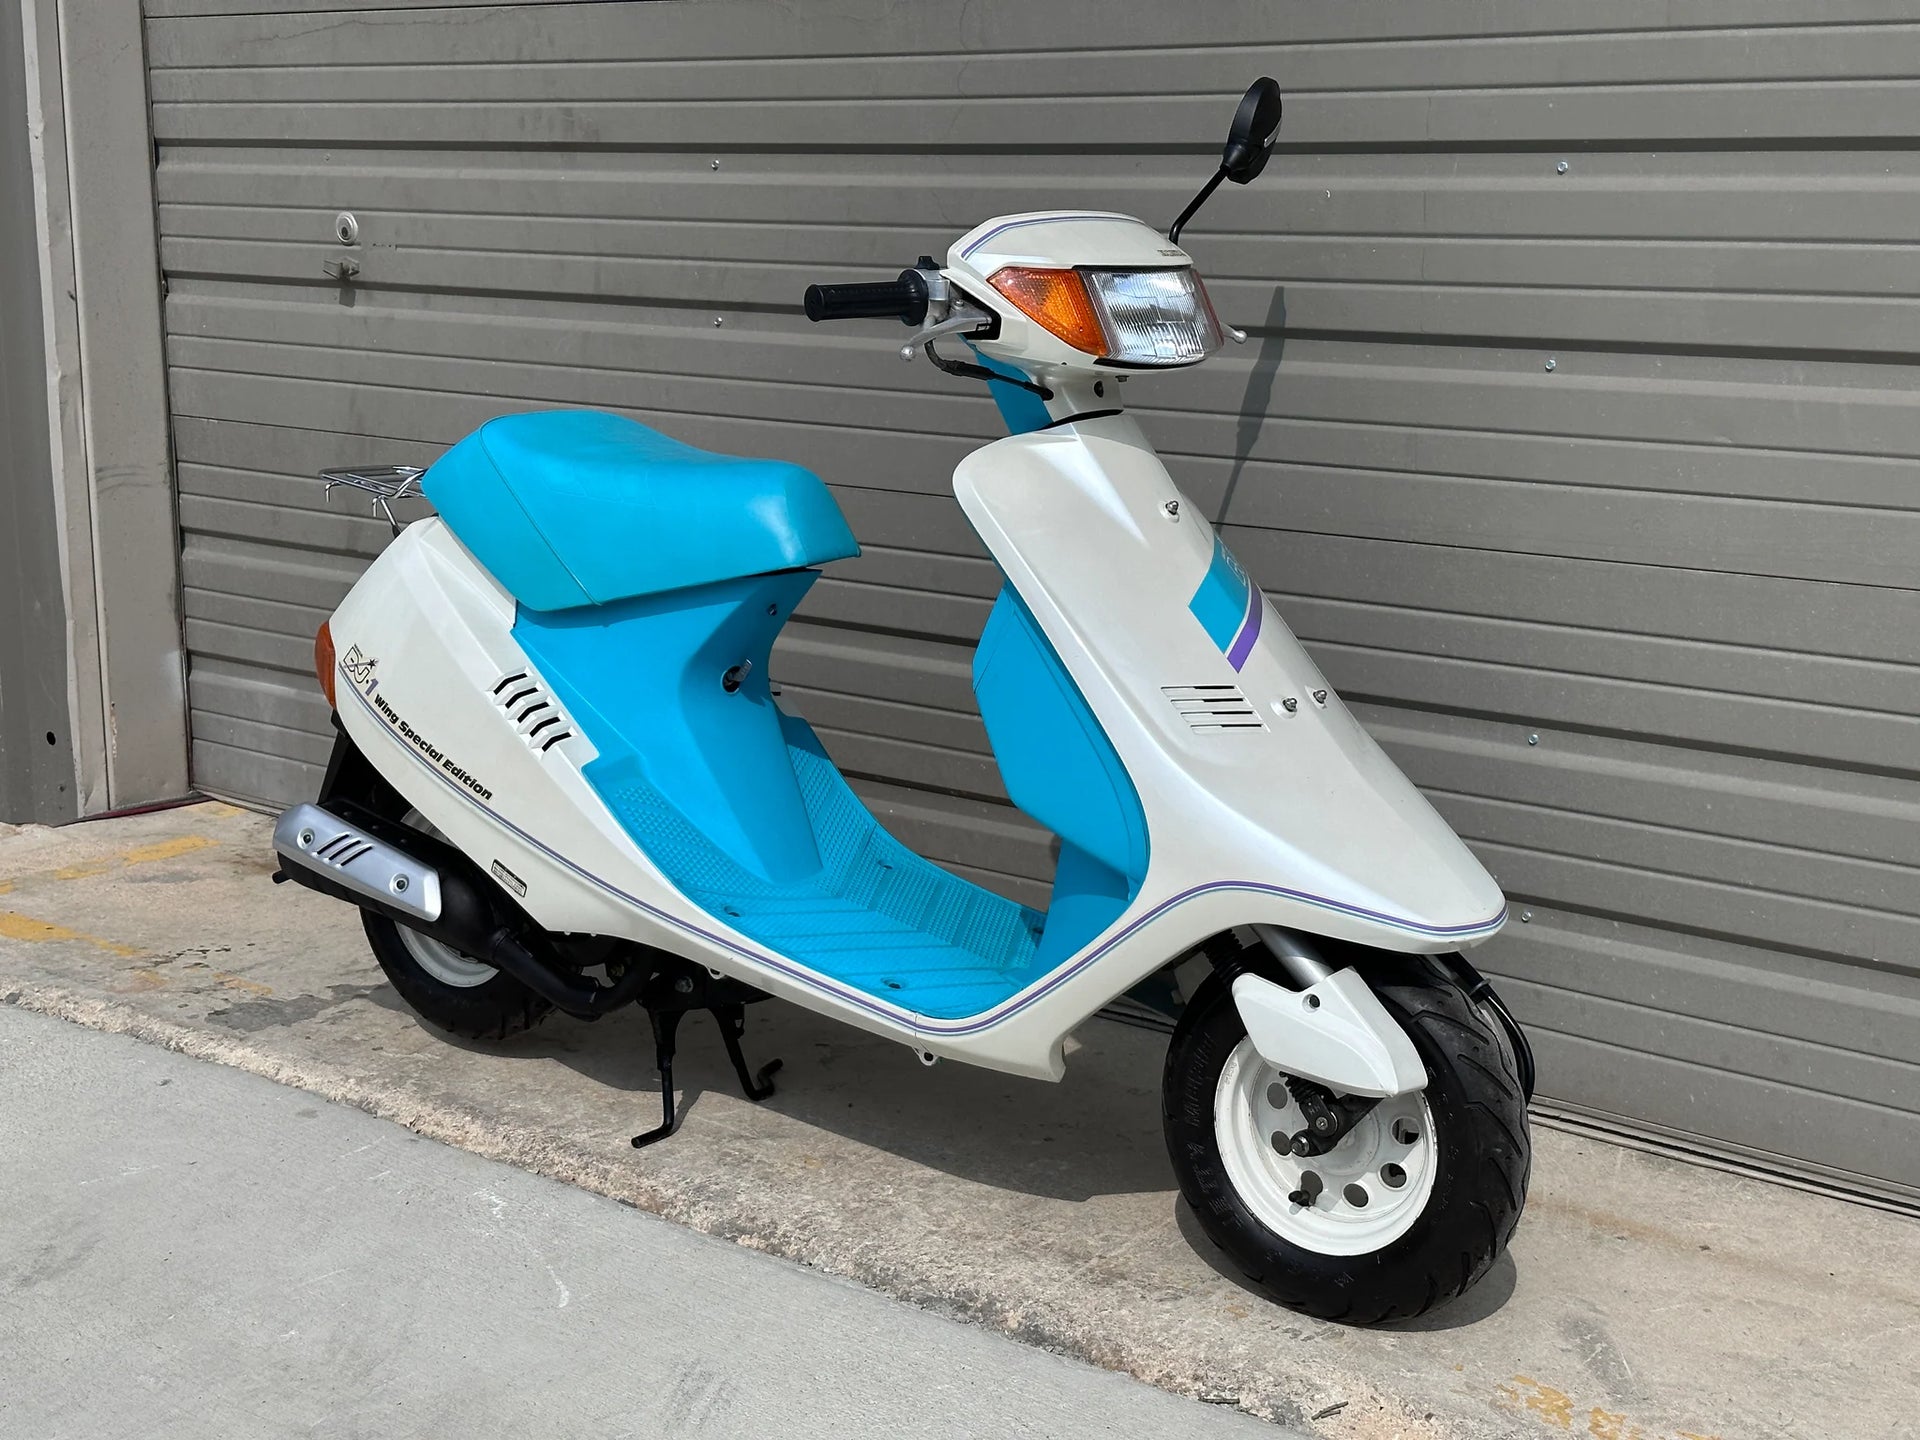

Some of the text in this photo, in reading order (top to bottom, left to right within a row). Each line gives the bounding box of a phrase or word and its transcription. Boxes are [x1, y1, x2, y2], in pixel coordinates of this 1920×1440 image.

[374, 694, 399, 725] Wing
[398, 719, 444, 763] Special
[441, 758, 493, 801] Edition
